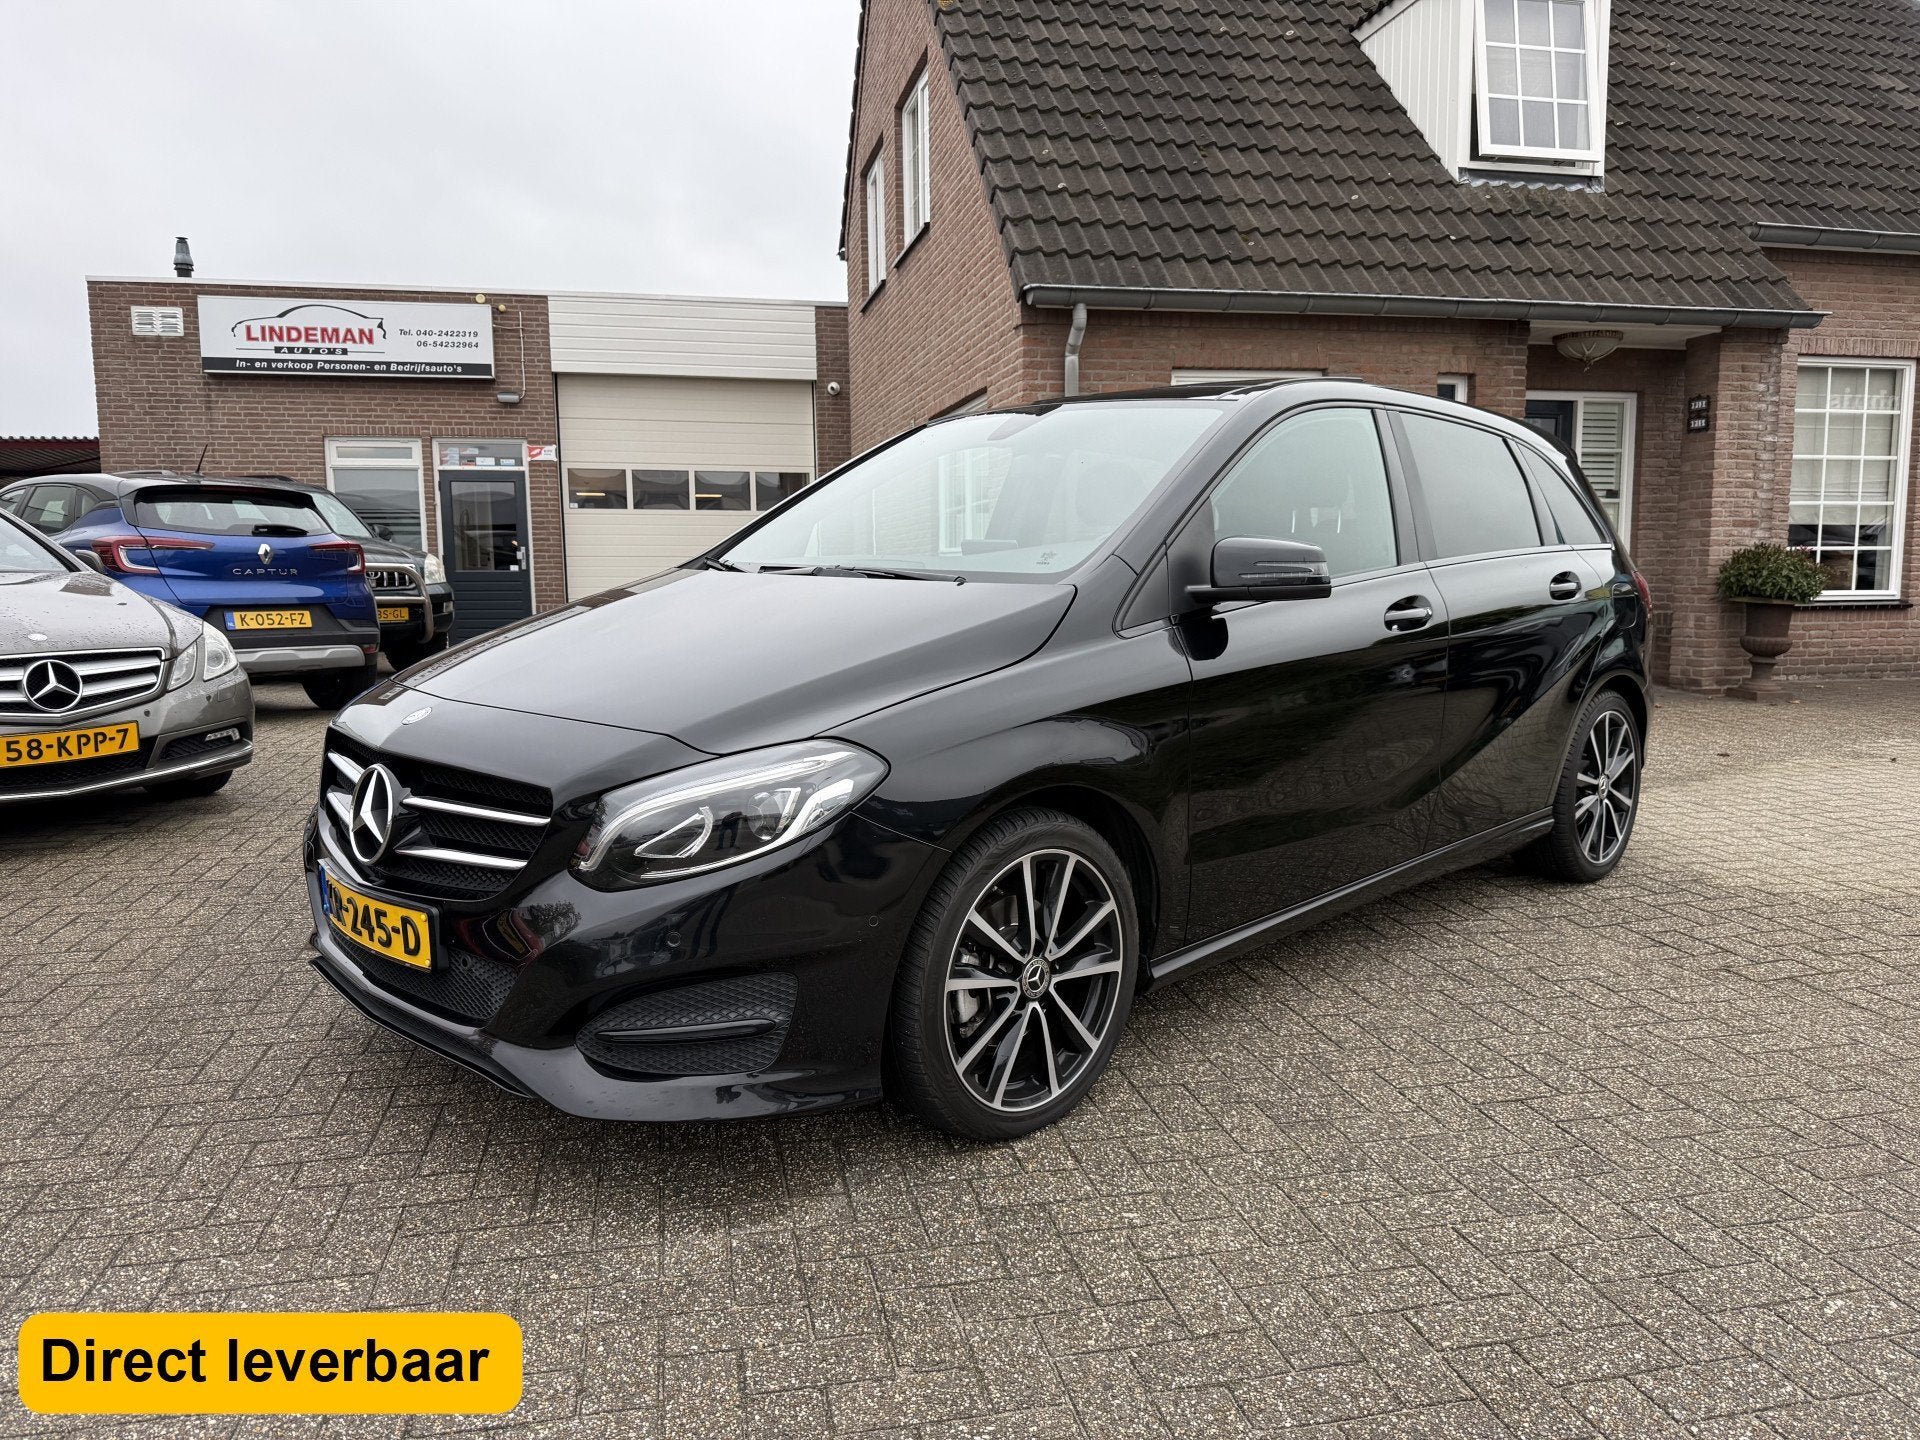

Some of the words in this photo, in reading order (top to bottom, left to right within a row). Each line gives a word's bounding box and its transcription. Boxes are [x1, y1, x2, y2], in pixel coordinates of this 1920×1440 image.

[245, 324, 375, 345] LINDEMAN
[399, 328, 413, 336] Tel.
[416, 329, 479, 338] 040-2422319
[416, 340, 479, 348] 06-54232964
[280, 347, 343, 355] AUTO'S
[236, 360, 251, 368] In-
[271, 361, 313, 371] verkoop
[317, 361, 371, 371] Personen-
[390, 363, 462, 373] Bedrijfsauto's
[232, 568, 298, 576] CAPTUR
[239, 612, 307, 627] K-052-FZ
[6, 727, 129, 762] 58-KPP-7
